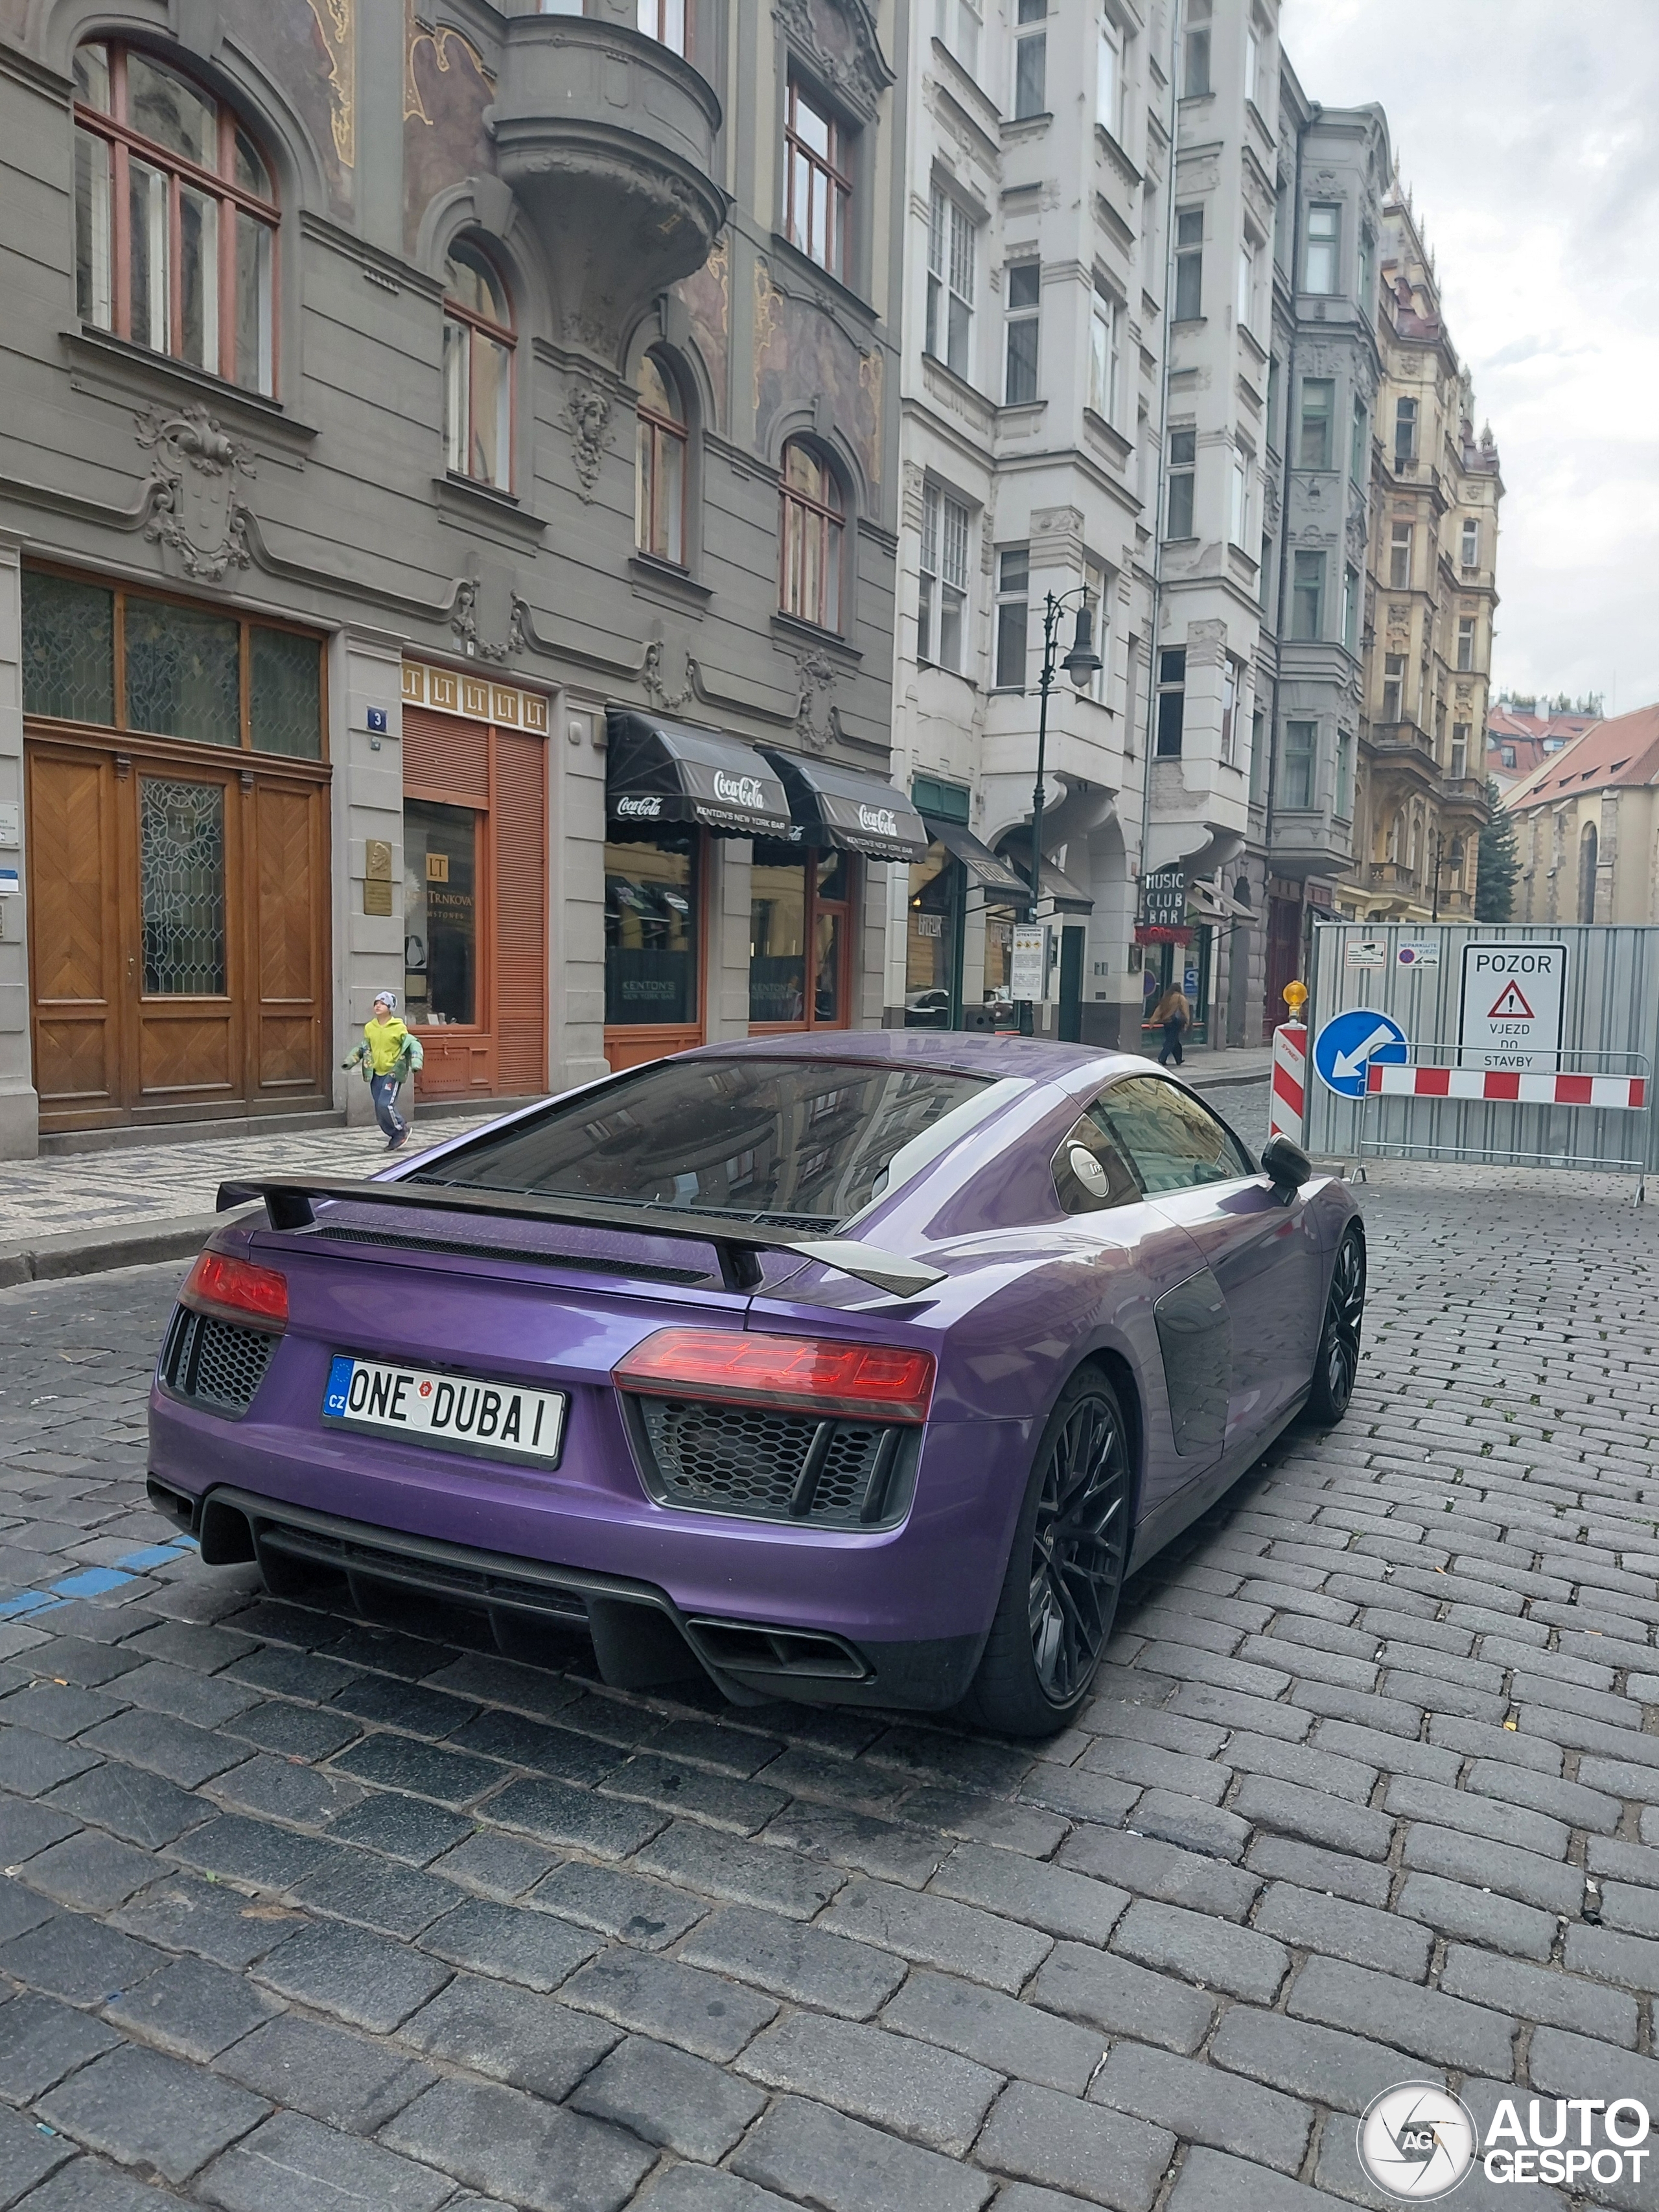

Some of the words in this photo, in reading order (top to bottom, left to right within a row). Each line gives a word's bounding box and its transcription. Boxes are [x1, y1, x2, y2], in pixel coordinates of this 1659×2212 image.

[402, 668, 421, 695] LT
[434, 676, 454, 704] LT
[466, 685, 486, 712] LT
[496, 693, 516, 719] LT
[526, 701, 544, 726] LT
[374, 712, 382, 726] 3
[713, 770, 765, 809] Coca-Cola
[617, 796, 664, 816] Coca-Cola
[696, 806, 734, 821] KENTON'S
[734, 814, 751, 824] NEW
[751, 817, 771, 828] YORK
[771, 820, 785, 831] BAR
[859, 804, 898, 837] Coca-Cola
[875, 841, 887, 850] NEW
[887, 844, 901, 853] YORK
[429, 857, 446, 877] LT
[1145, 872, 1185, 890] MUSIC
[1146, 892, 1183, 908] CLUB
[1148, 909, 1178, 924] BAR
[1476, 955, 1551, 973] POZOR
[622, 981, 675, 990] KENTON'S
[1490, 1023, 1530, 1035] VJEZD
[1500, 1040, 1518, 1049] DO
[1484, 1055, 1533, 1067] STAVBY
[329, 1394, 345, 1410] CZ
[349, 1369, 414, 1421] ONE
